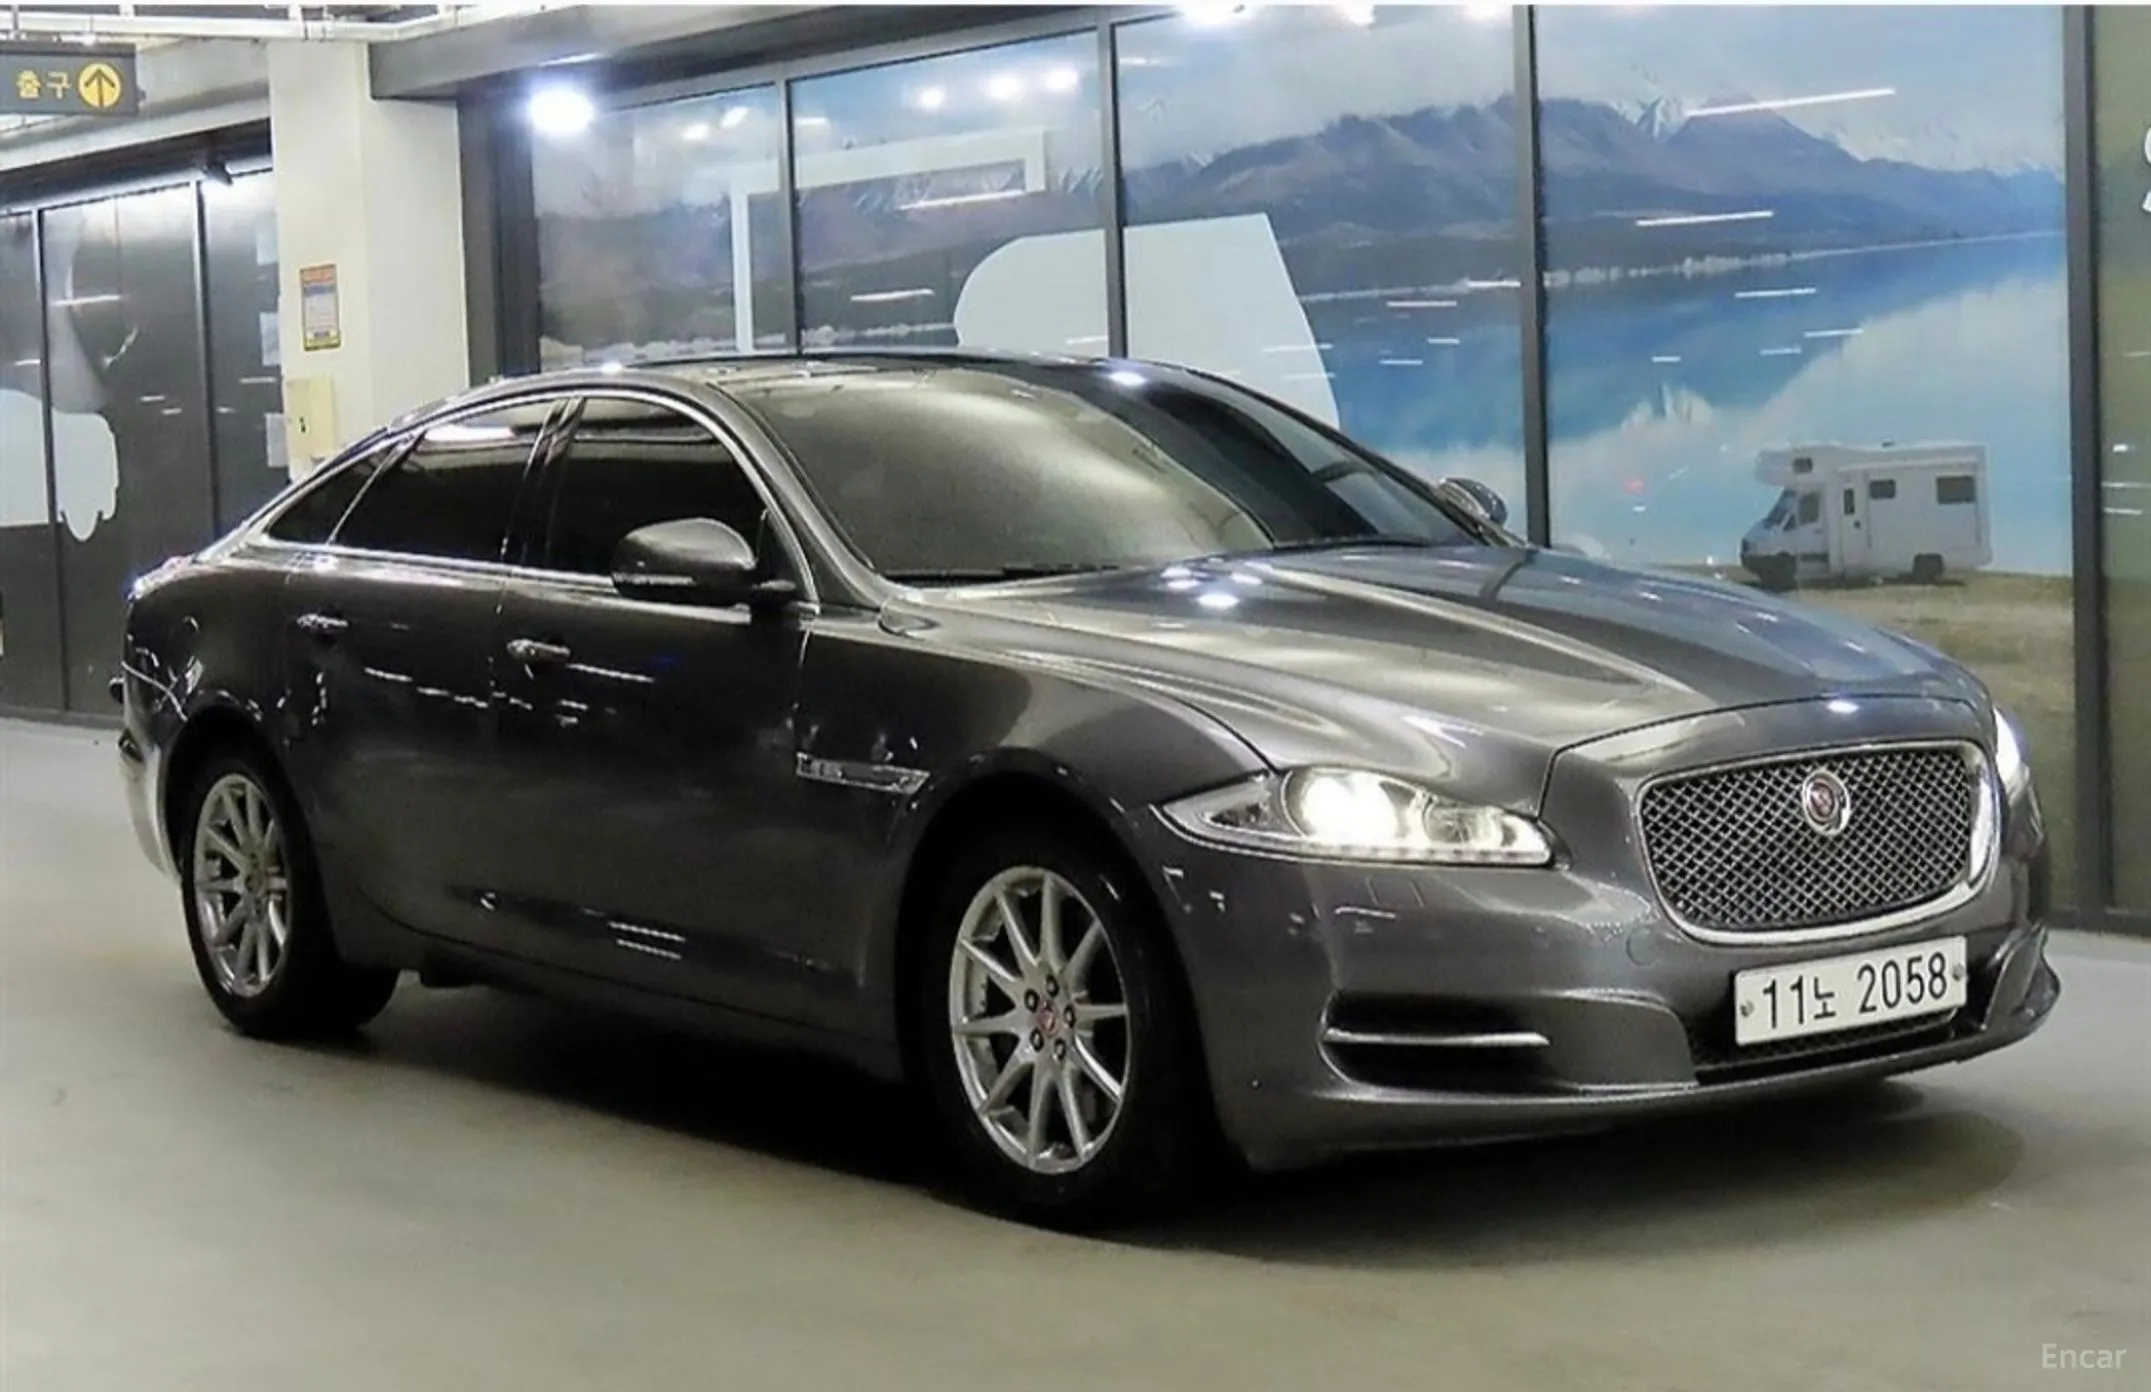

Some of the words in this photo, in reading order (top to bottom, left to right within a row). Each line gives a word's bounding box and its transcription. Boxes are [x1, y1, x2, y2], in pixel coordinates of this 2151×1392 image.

[16, 69, 72, 99] 출구
[1762, 974, 1836, 1030] 11노
[1857, 951, 1948, 1015] 2058
